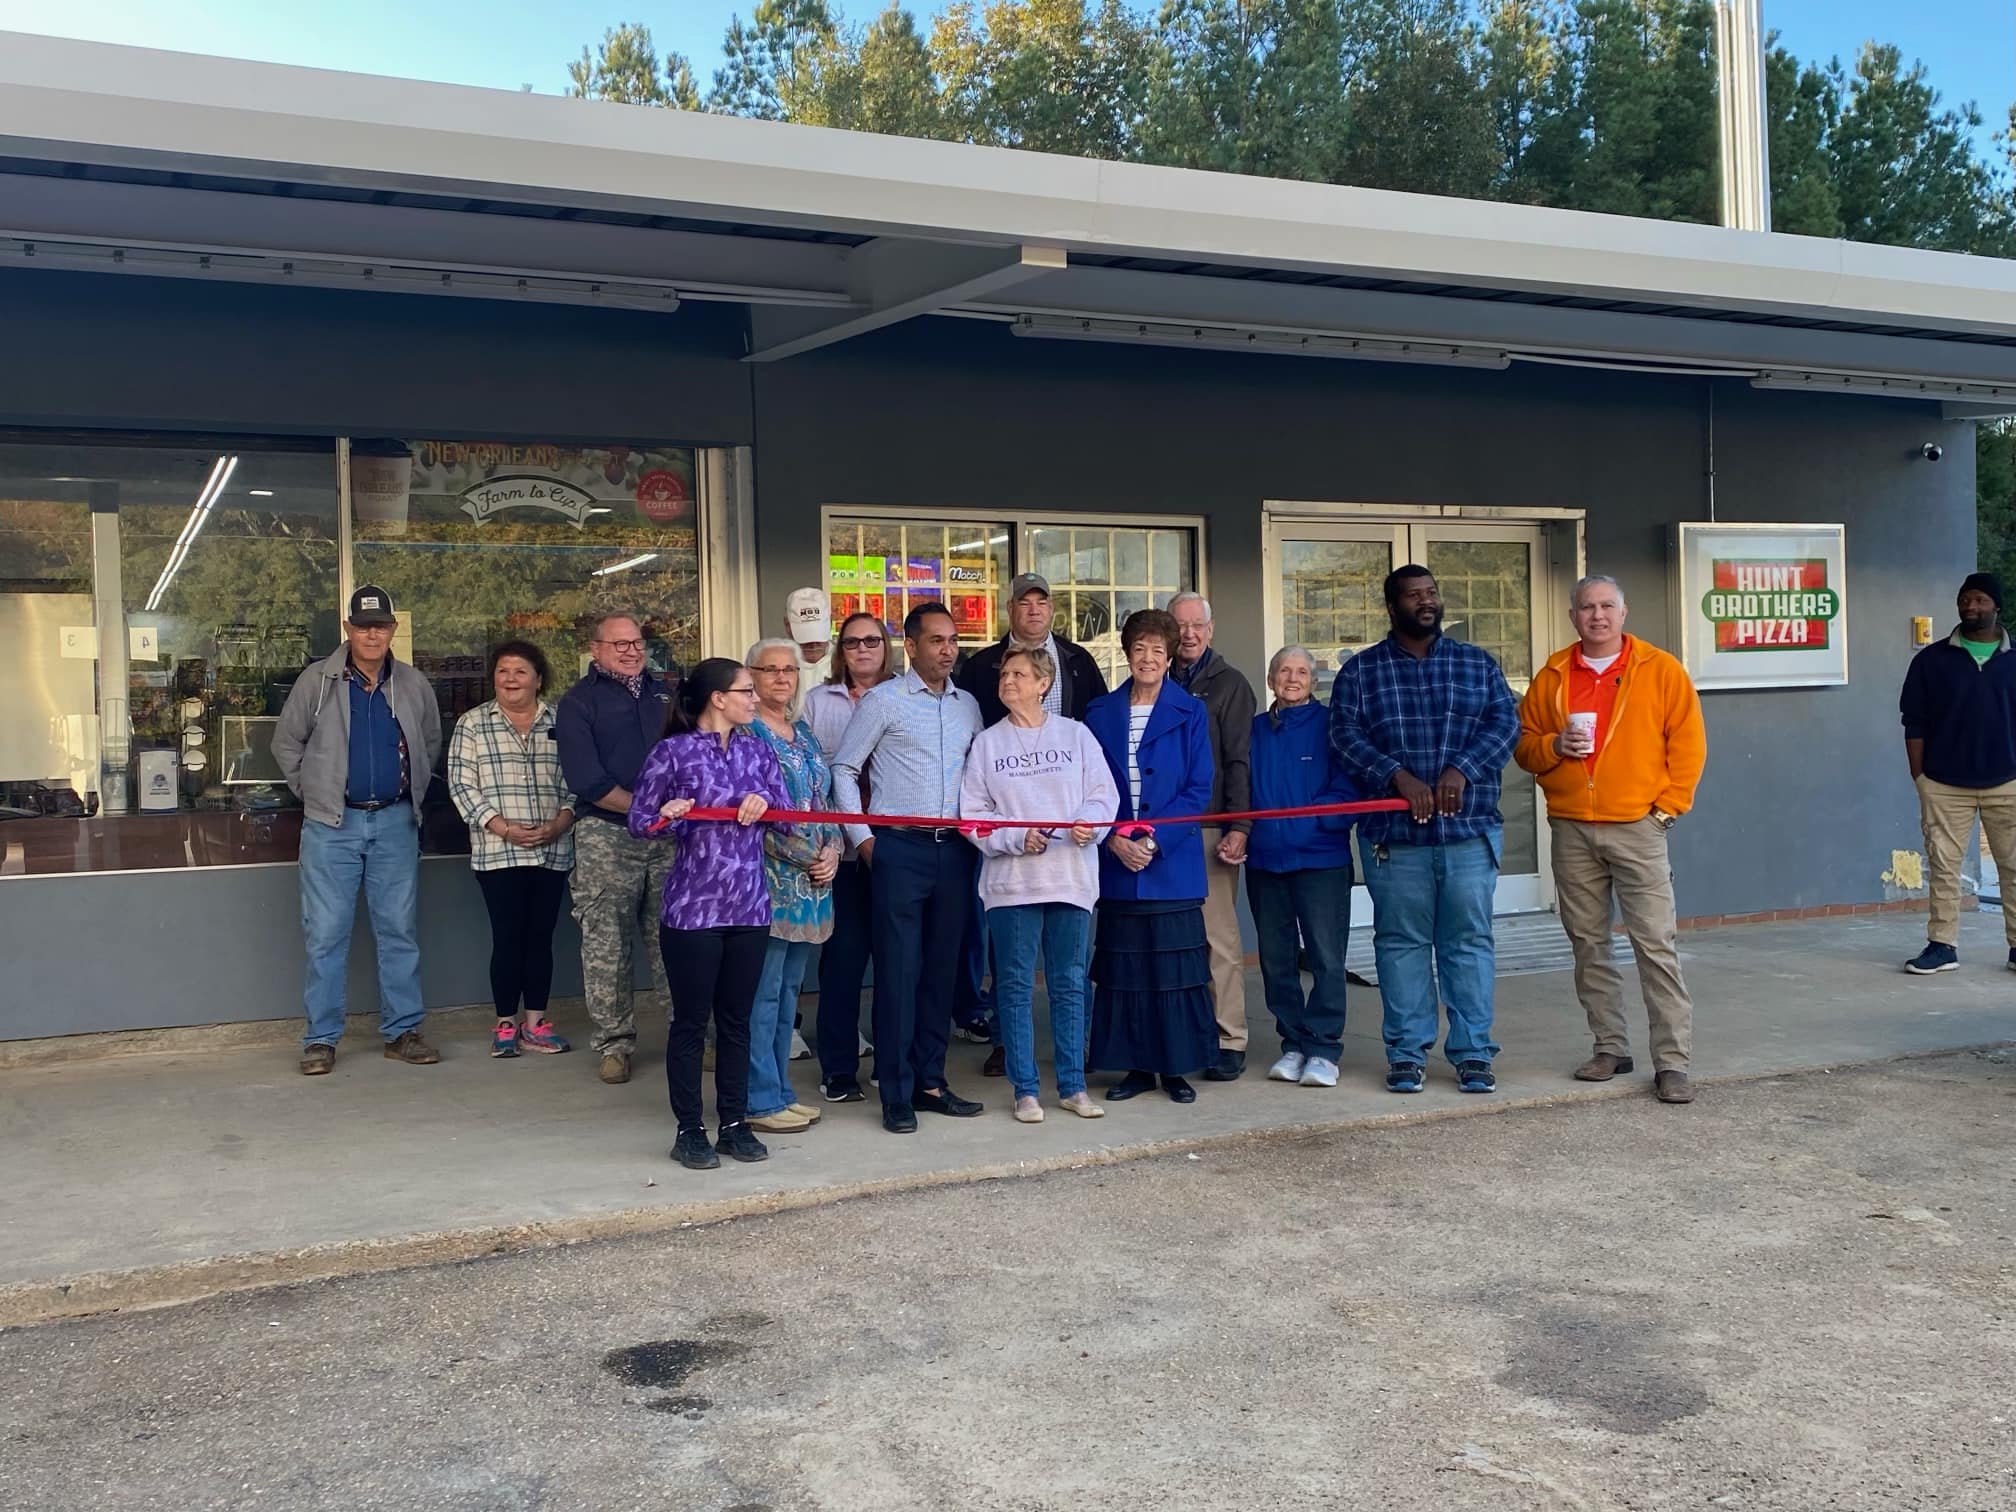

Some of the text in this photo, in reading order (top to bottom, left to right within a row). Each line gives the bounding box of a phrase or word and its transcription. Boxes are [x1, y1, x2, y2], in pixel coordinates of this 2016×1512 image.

[478, 484, 578, 513] Farm to Cup
[1736, 566, 1804, 592] HUNT
[1710, 593, 1832, 618] BROTHERS
[1737, 618, 1808, 645] PIZZA
[994, 749, 1073, 773] BOSTON
